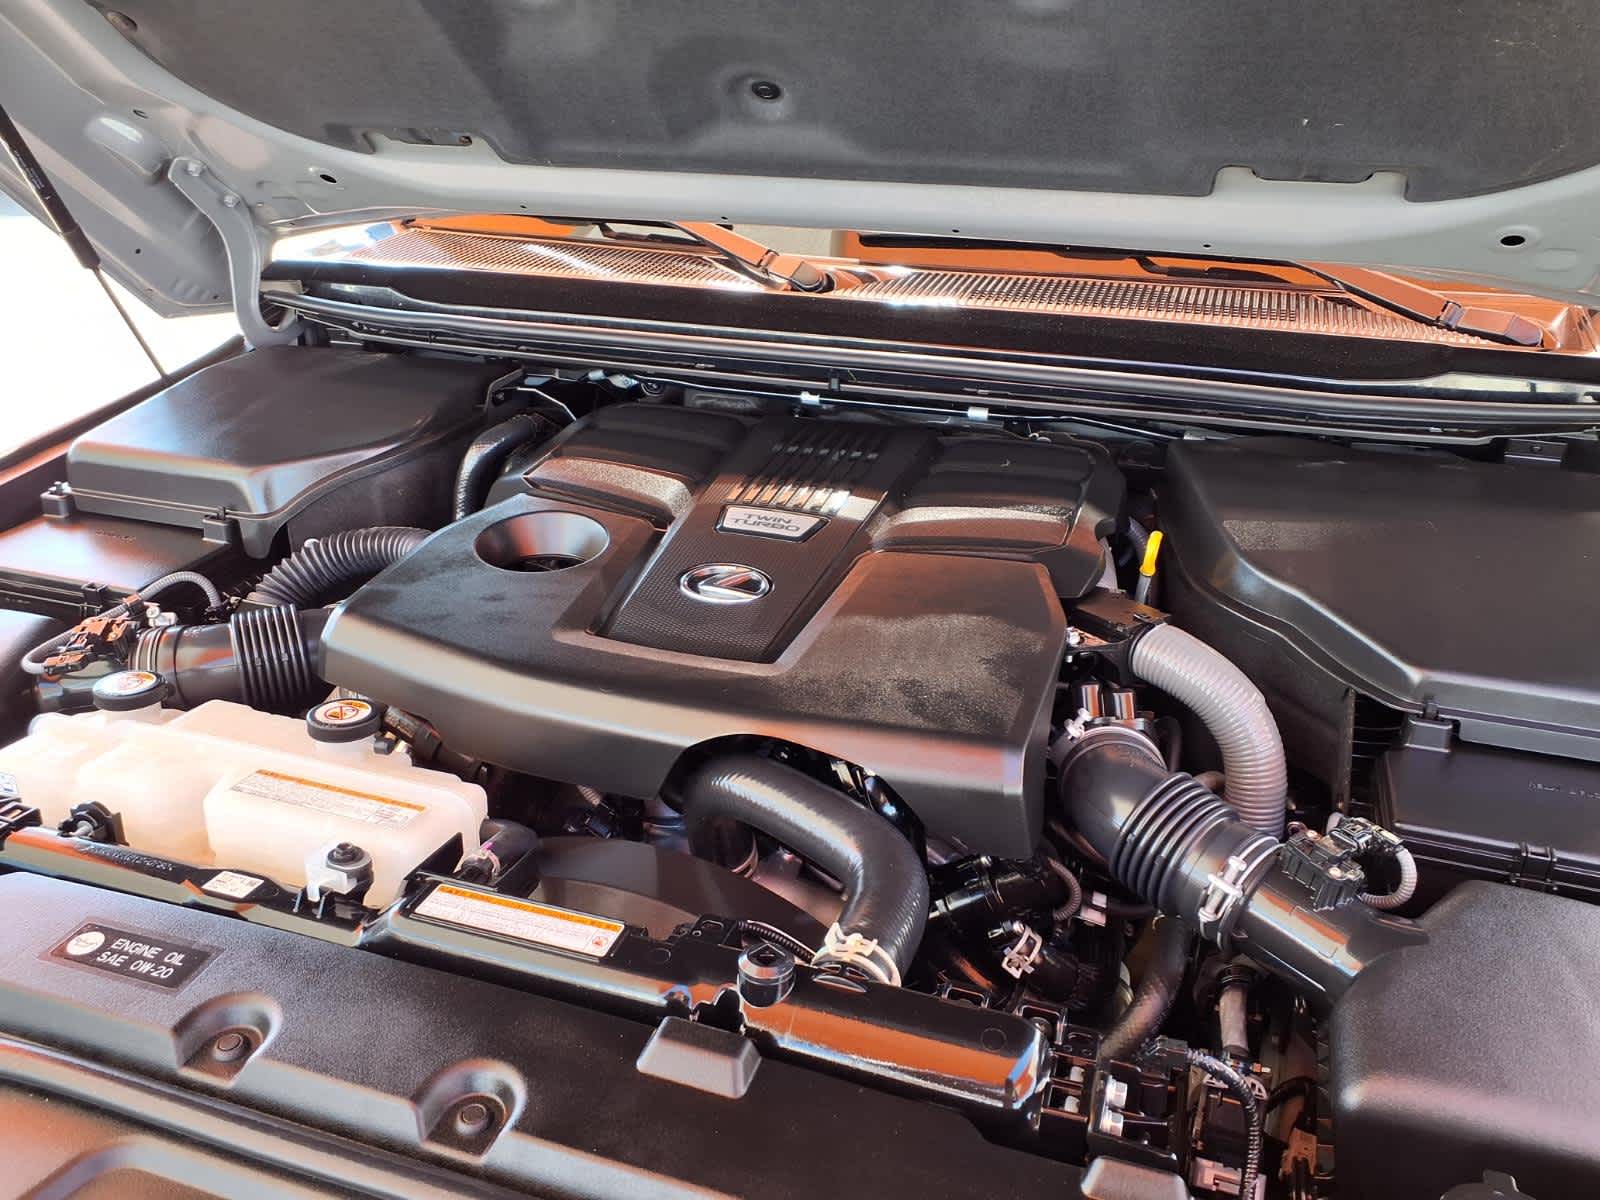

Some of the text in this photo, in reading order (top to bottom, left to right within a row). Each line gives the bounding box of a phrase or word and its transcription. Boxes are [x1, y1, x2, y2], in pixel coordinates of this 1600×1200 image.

[734, 518, 800, 532] TURBO
[744, 513, 792, 524] TWIN
[111, 938, 186, 966] ENGINE OIL
[96, 951, 175, 979] SAE 0W-20
